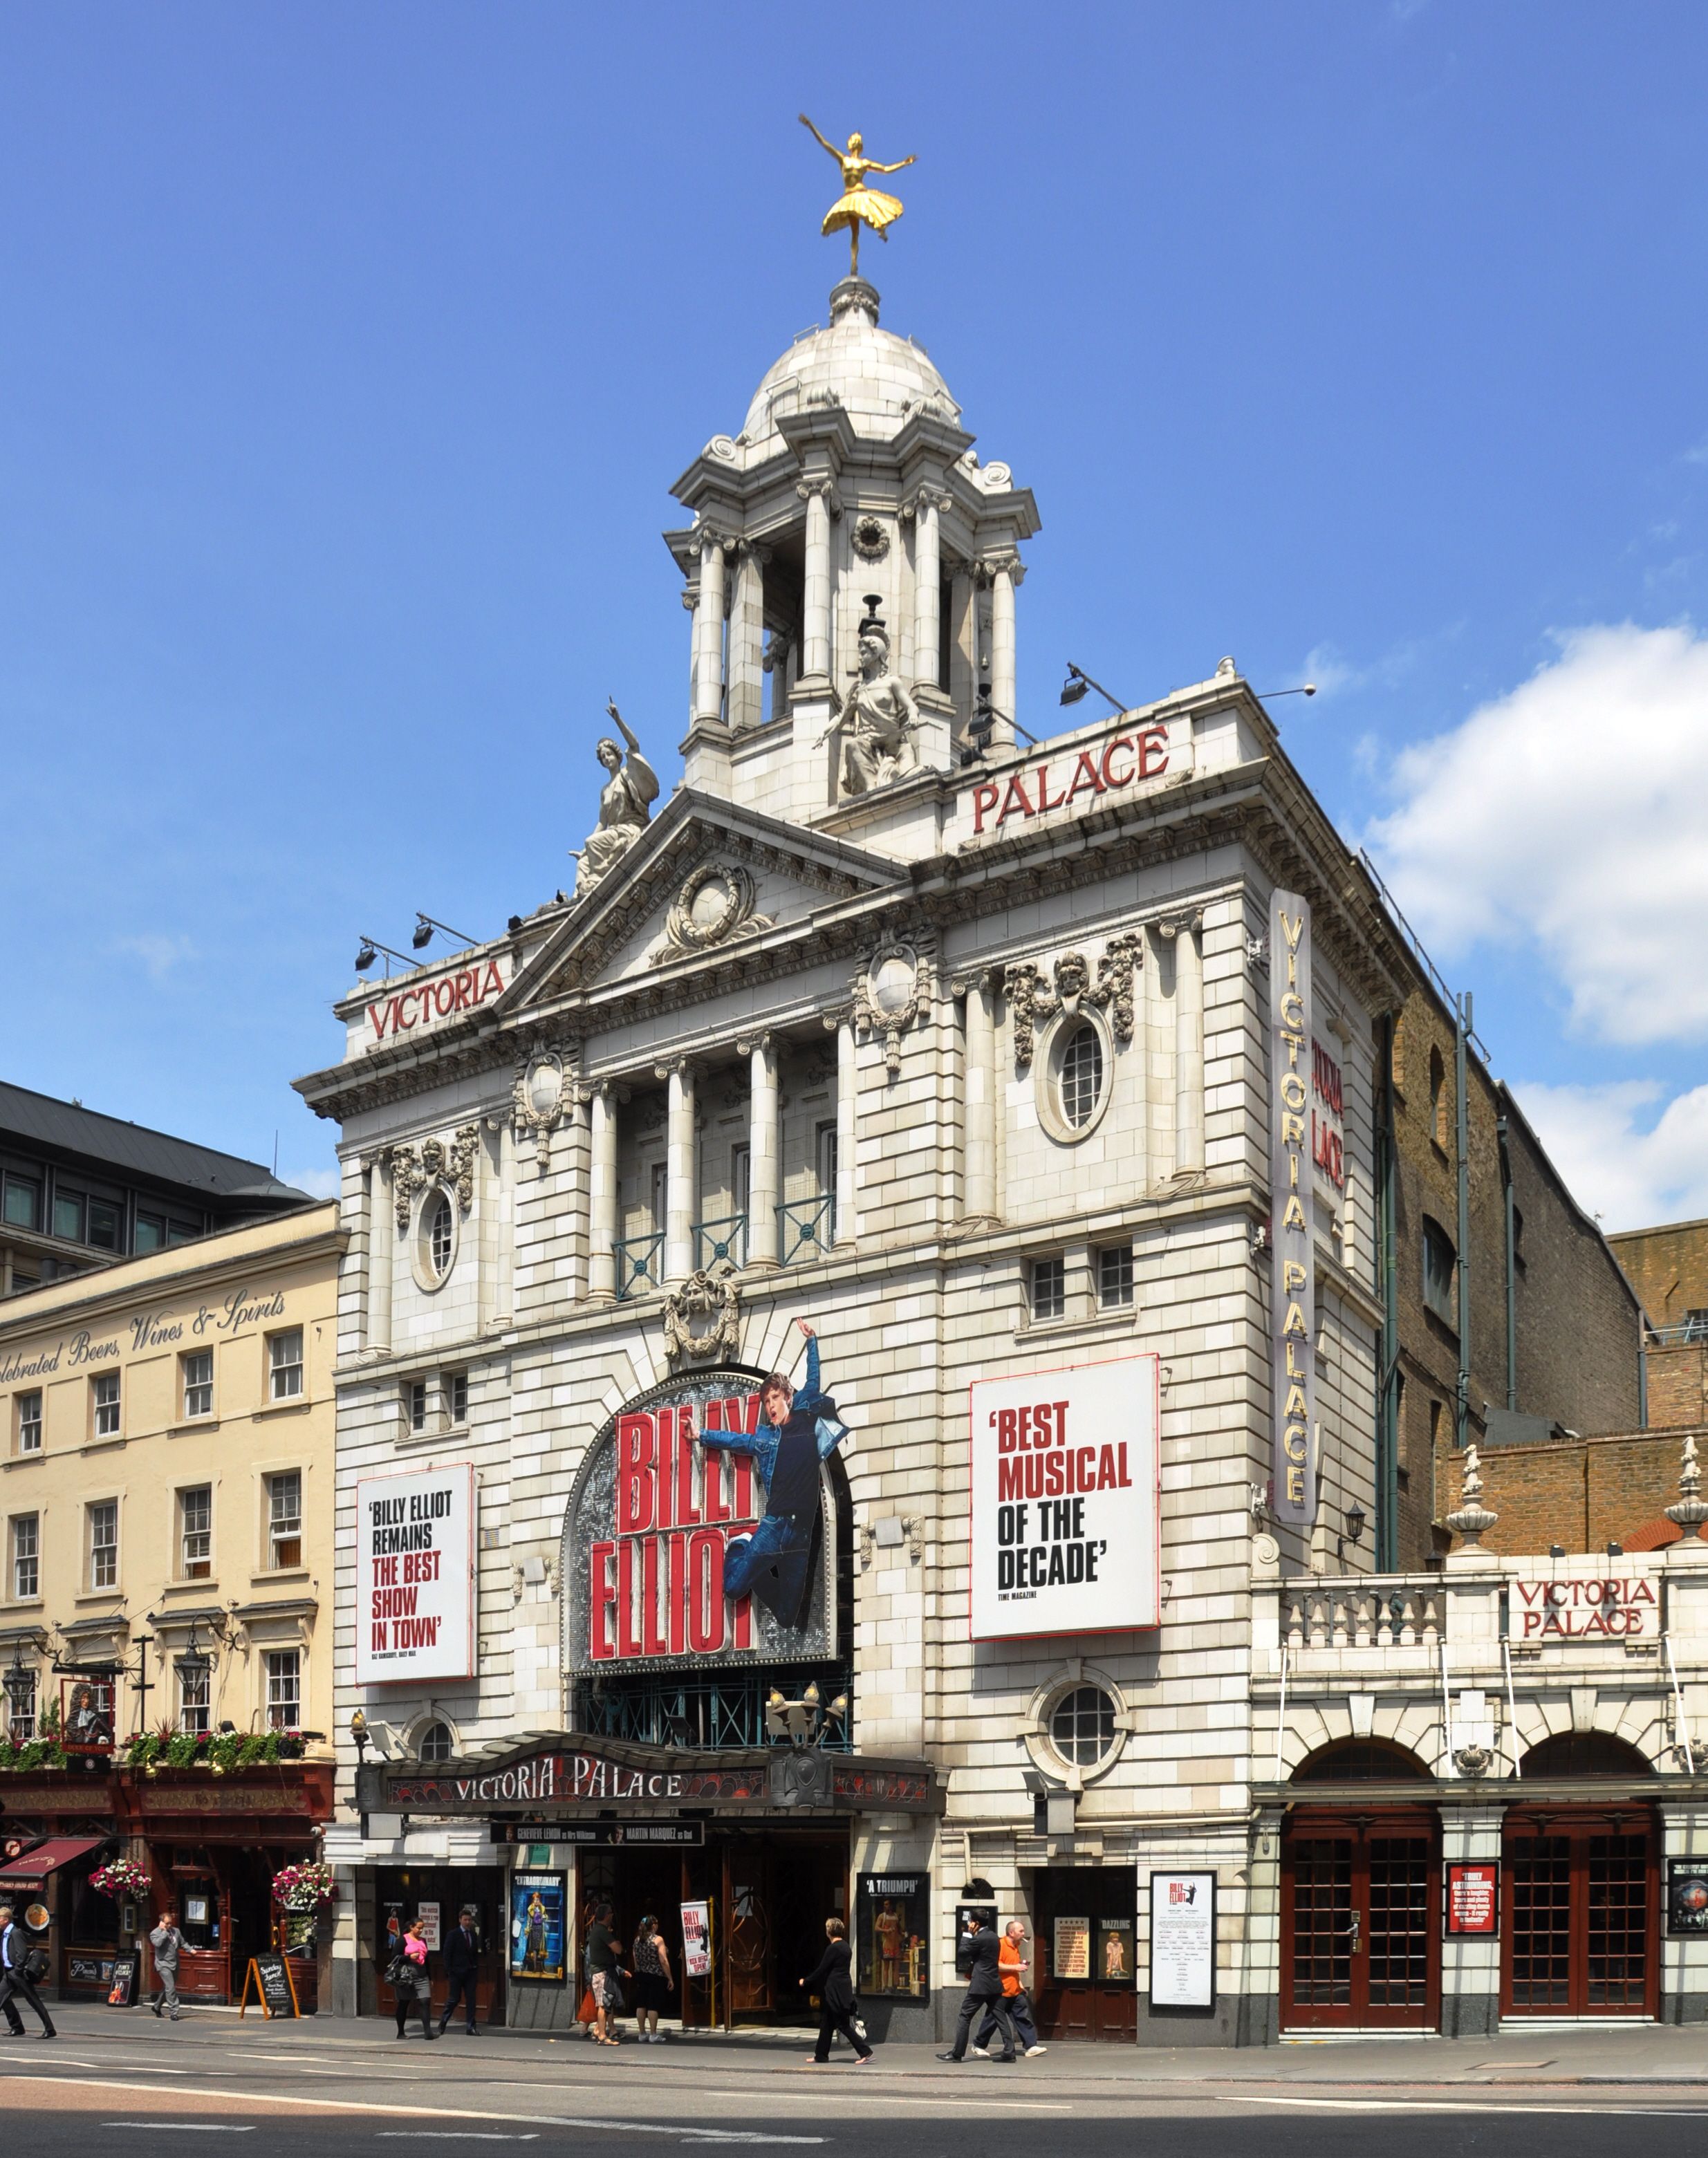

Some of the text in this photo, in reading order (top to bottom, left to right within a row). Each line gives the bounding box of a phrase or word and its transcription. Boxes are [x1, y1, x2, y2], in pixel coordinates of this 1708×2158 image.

[974, 725, 1169, 834] PALACE
[368, 960, 505, 1039] VICTORIA
[1279, 909, 1307, 1503] VICTORIA PALACE
[68, 1330, 120, 1366] Beers,
[129, 1310, 183, 1351] Wines
[192, 1305, 216, 1336] &
[217, 1288, 285, 1334] Spirits
[616, 1392, 762, 1536] BILLY
[998, 1441, 1133, 1503] MUSICAL
[410, 1490, 453, 1522] ELLIOT
[998, 1496, 1085, 1547] OF THE
[372, 1523, 433, 1556] REMAINS
[371, 1550, 441, 1588] THE BEST
[371, 1585, 418, 1620] SHOW
[589, 1523, 760, 1661] ELLIOT
[998, 1590, 1037, 1601] TIME MAGAZINE
[1516, 1579, 1656, 1607] VICTORIA
[371, 1621, 387, 1652] IN
[1523, 1607, 1644, 1637] PALACE
[456, 1756, 682, 1800] VICTORIA PALACE
[517, 1827, 543, 1840] GENEVIEVE
[544, 1827, 561, 1840] LEMON
[626, 1827, 648, 1839] MARTIN
[649, 1827, 676, 1841] MARQUEZ
[1169, 1883, 1183, 1892] BILLY
[1169, 1892, 1186, 1903] ELLIOT
[683, 1910, 700, 1926] BILLY
[685, 1924, 704, 1940] ELLIOT
[260, 1964, 282, 1975] Sunday
